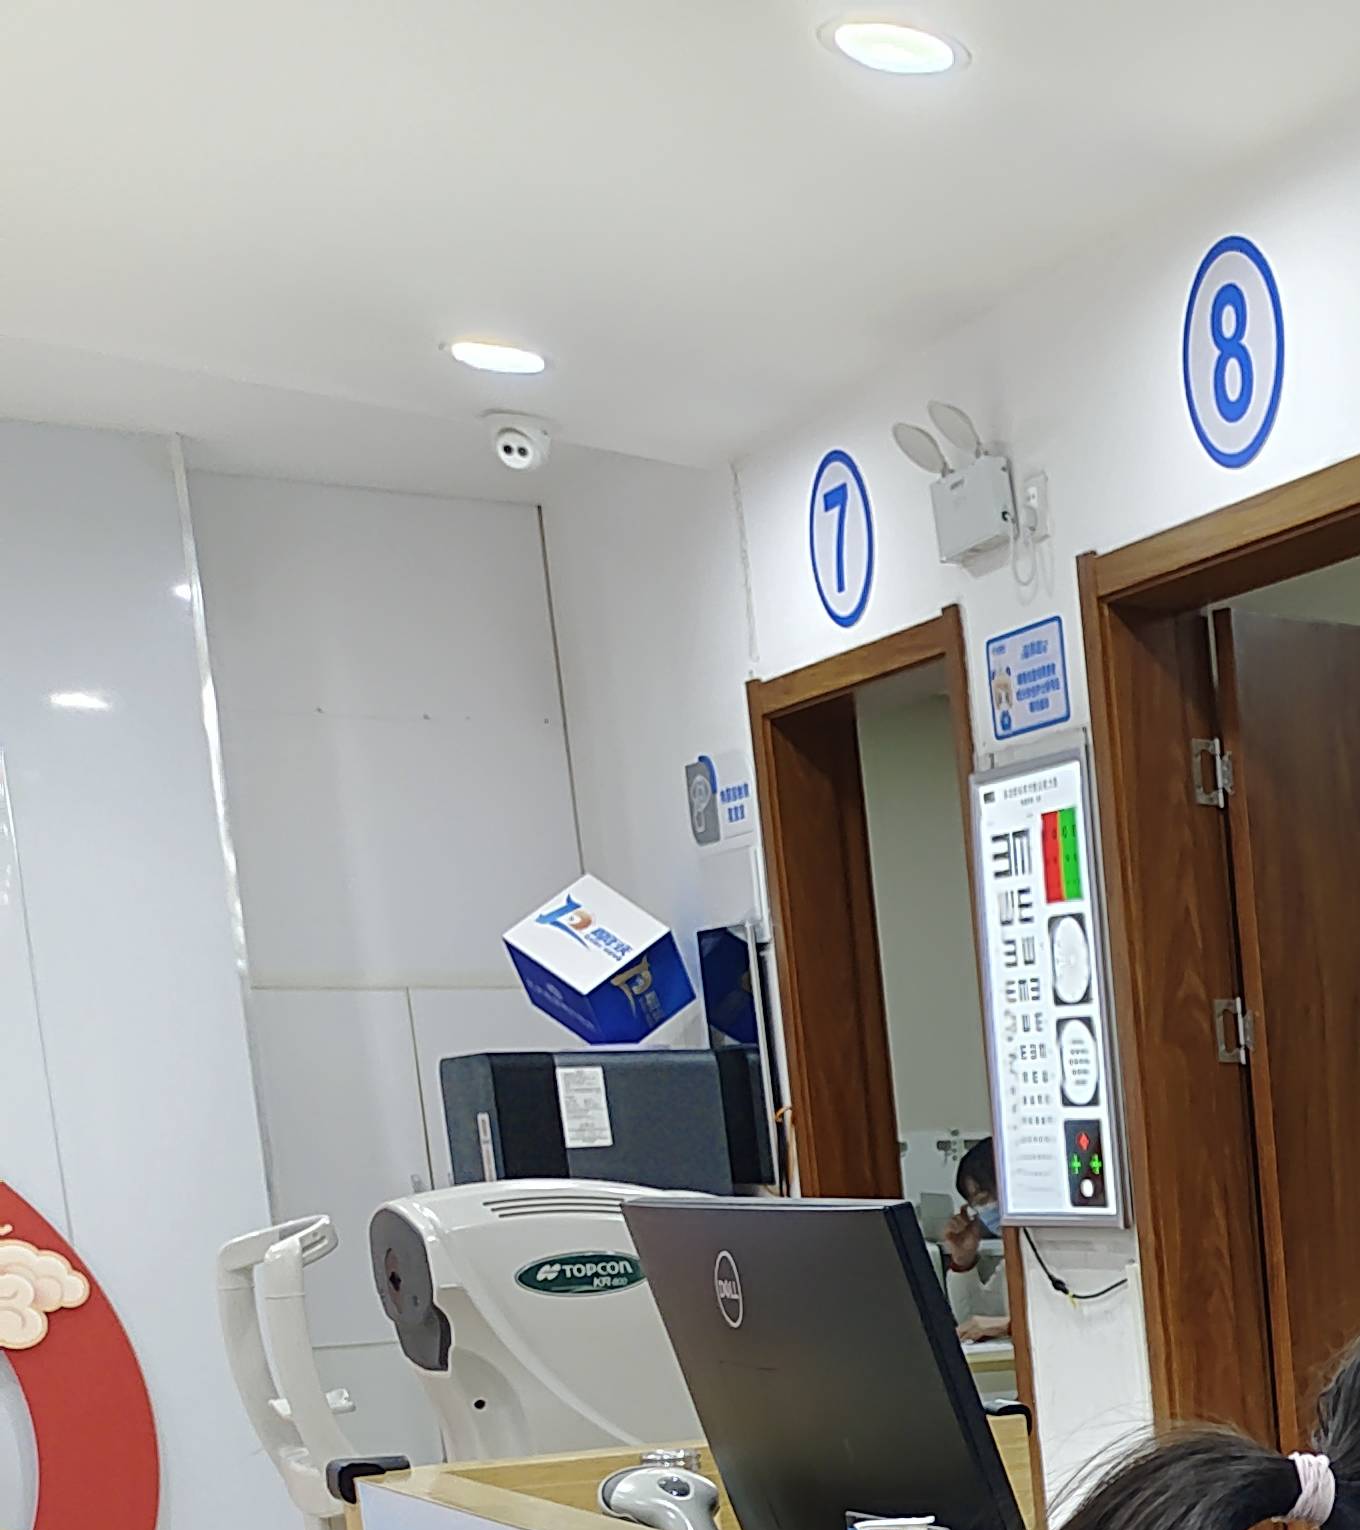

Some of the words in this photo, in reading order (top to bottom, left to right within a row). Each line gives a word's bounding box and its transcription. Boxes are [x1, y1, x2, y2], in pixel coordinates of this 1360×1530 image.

[1211, 283, 1253, 423] 8
[823, 482, 848, 593] 7
[562, 1259, 633, 1278] TOPCON
